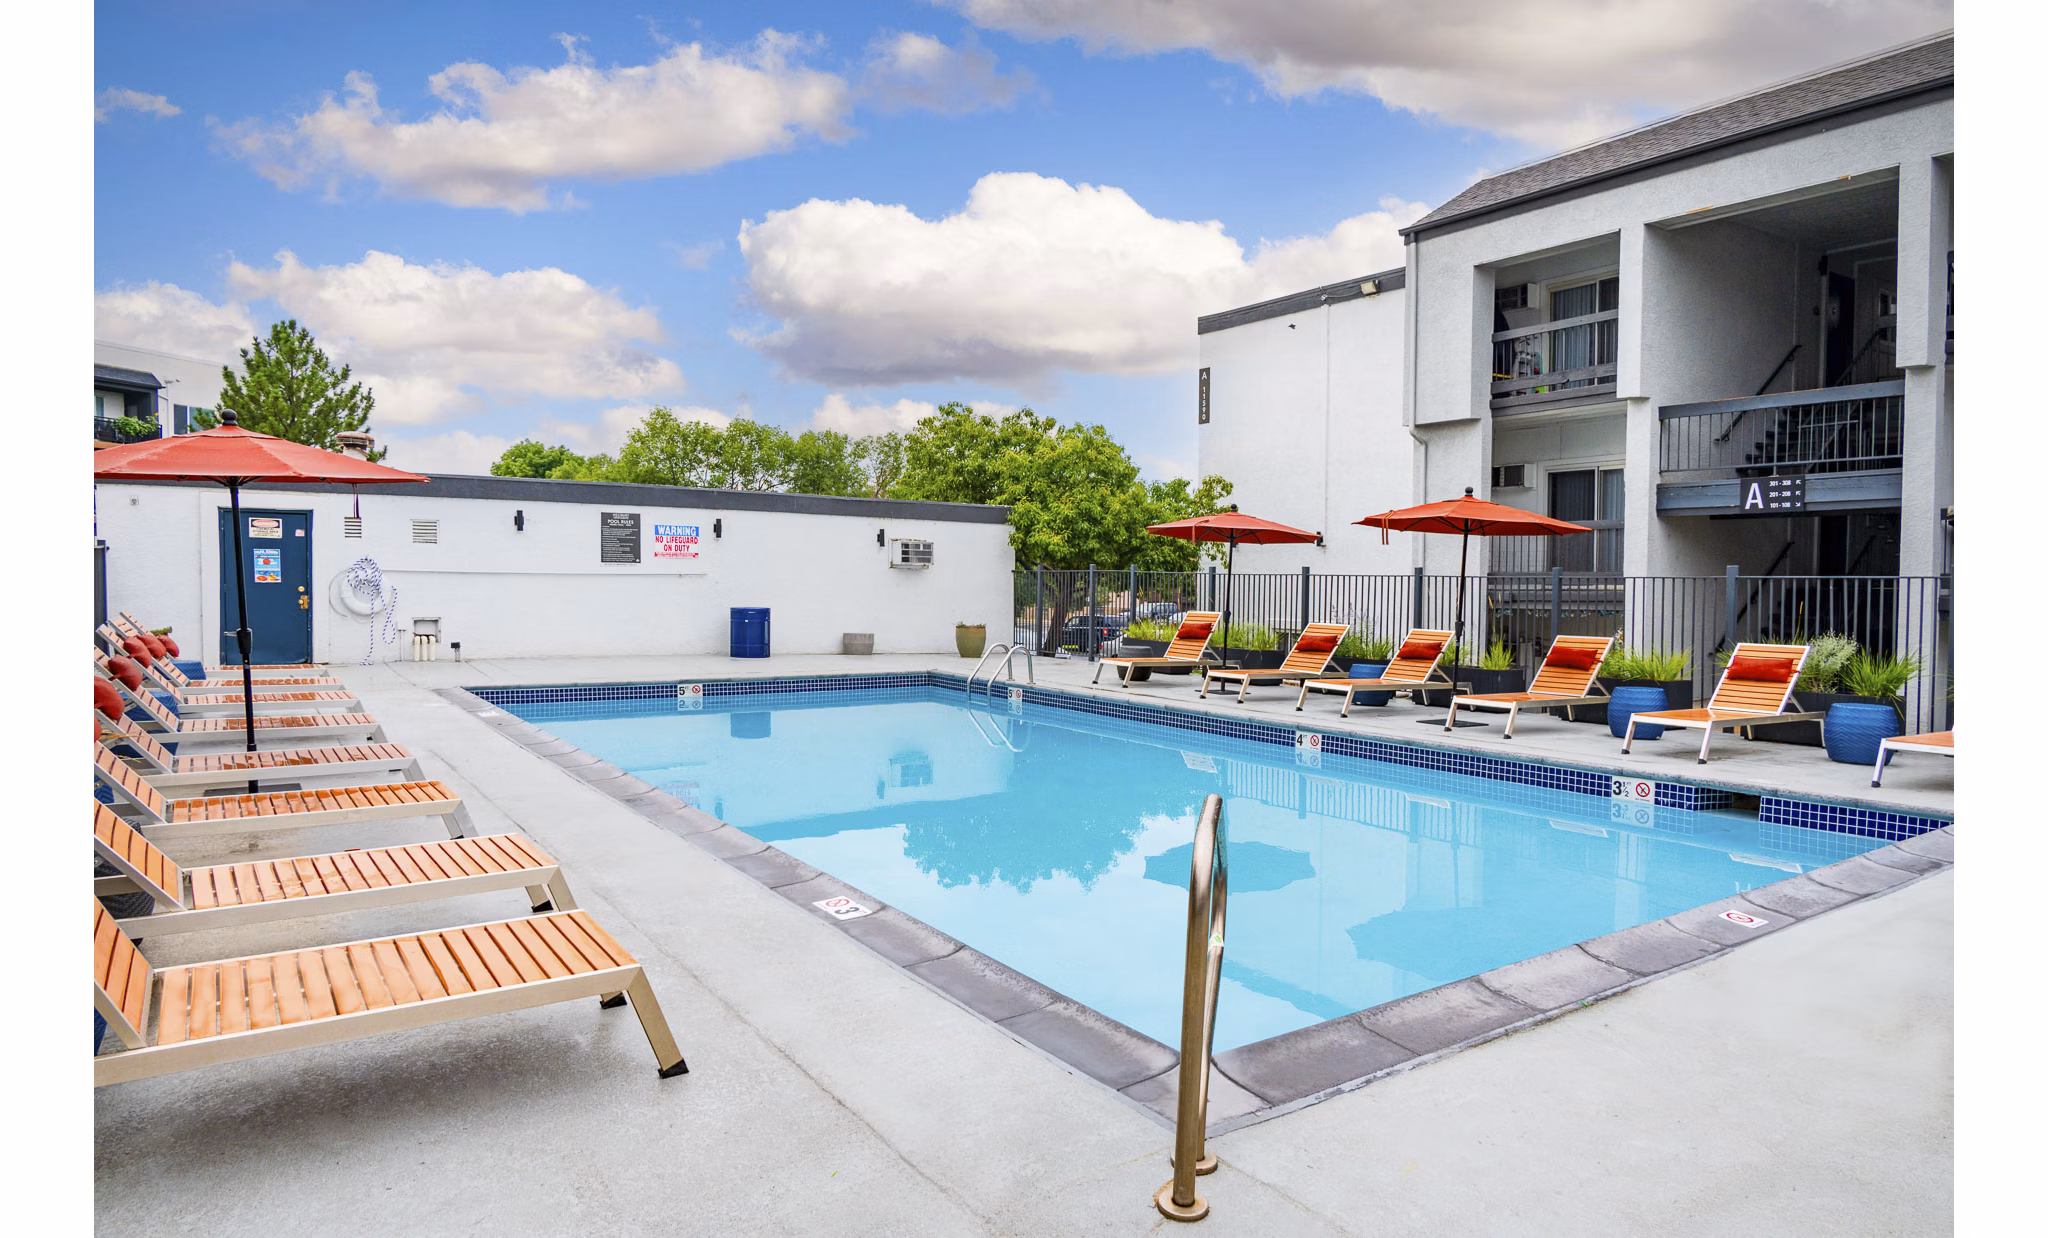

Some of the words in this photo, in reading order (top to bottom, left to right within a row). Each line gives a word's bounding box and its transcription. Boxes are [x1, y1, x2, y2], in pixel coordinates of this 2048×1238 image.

[1202, 371, 1208, 380] A
[1744, 482, 1764, 509] A
[657, 525, 696, 536] WARNING
[655, 535, 664, 543] NO
[666, 536, 699, 544] LIFEGUARD
[663, 544, 672, 552] ON
[674, 544, 690, 552] DUTY
[1297, 734, 1303, 746] 4
